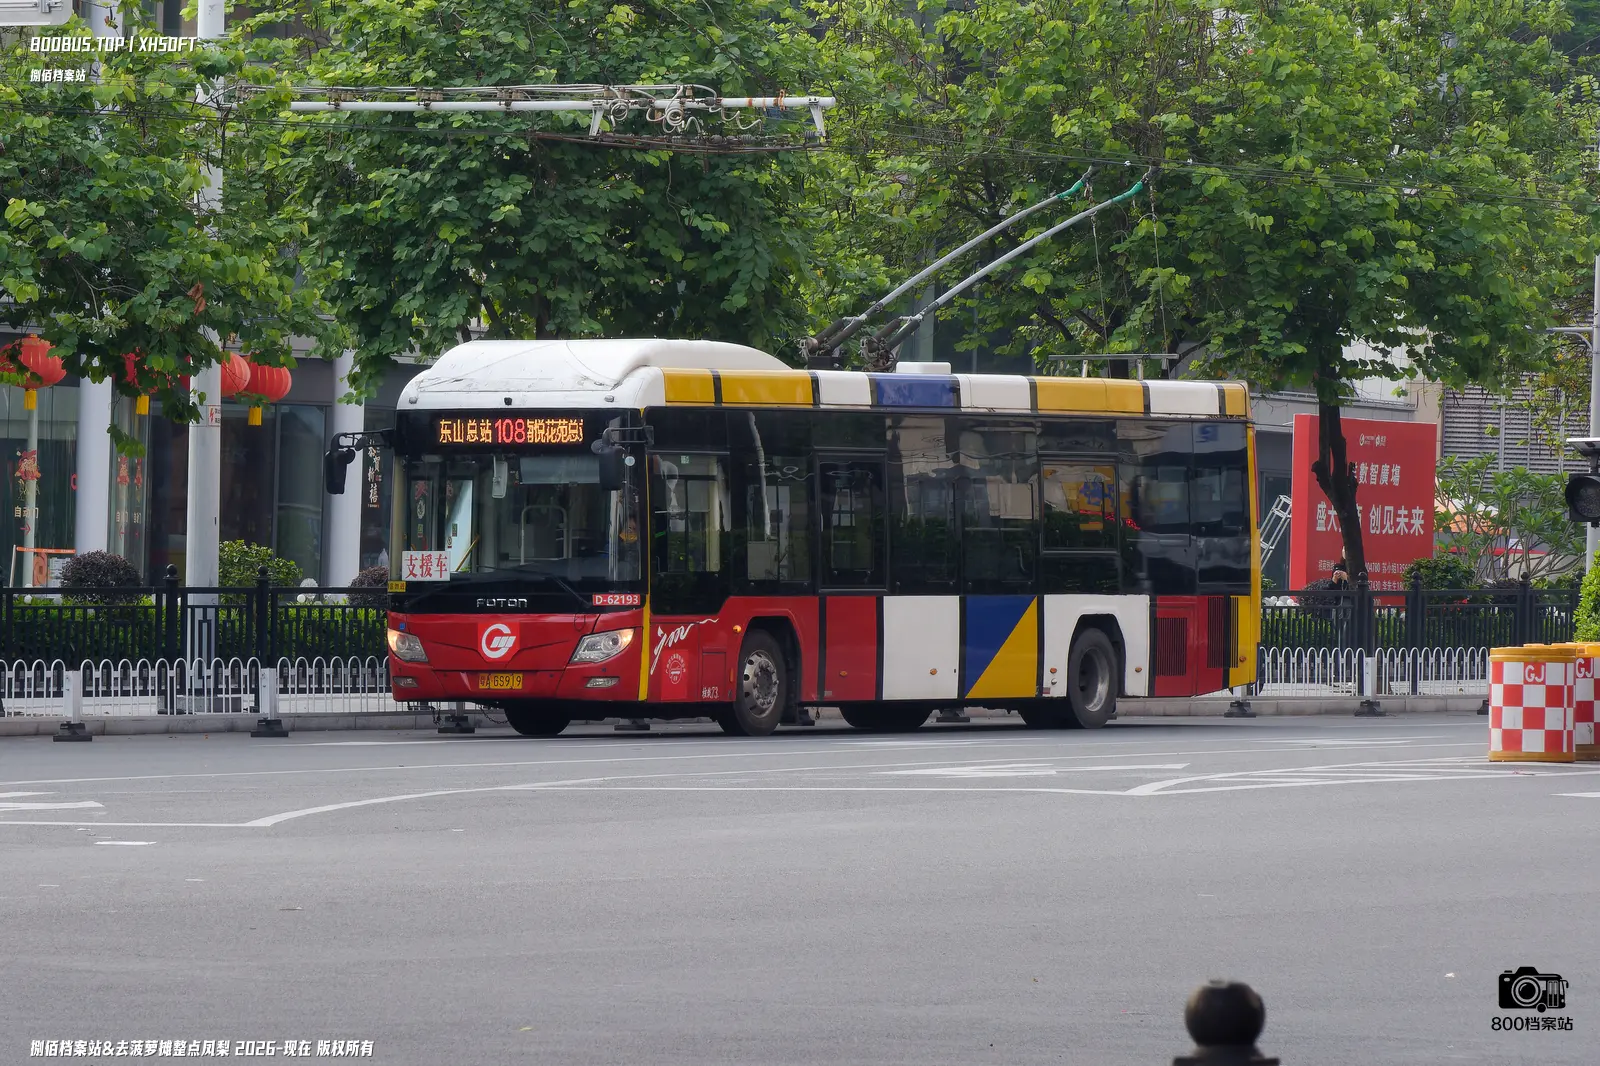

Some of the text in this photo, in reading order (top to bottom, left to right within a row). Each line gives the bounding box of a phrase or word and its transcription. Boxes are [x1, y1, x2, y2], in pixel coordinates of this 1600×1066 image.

[439, 418, 492, 443] 东山总站
[494, 418, 526, 443] 108
[1369, 504, 1424, 536] 创见未来
[404, 553, 448, 579] 支援车
[476, 598, 528, 608] FOTON
[595, 594, 639, 605] D-62193
[1525, 664, 1545, 682] GJ
[1576, 657, 1593, 678] GJ
